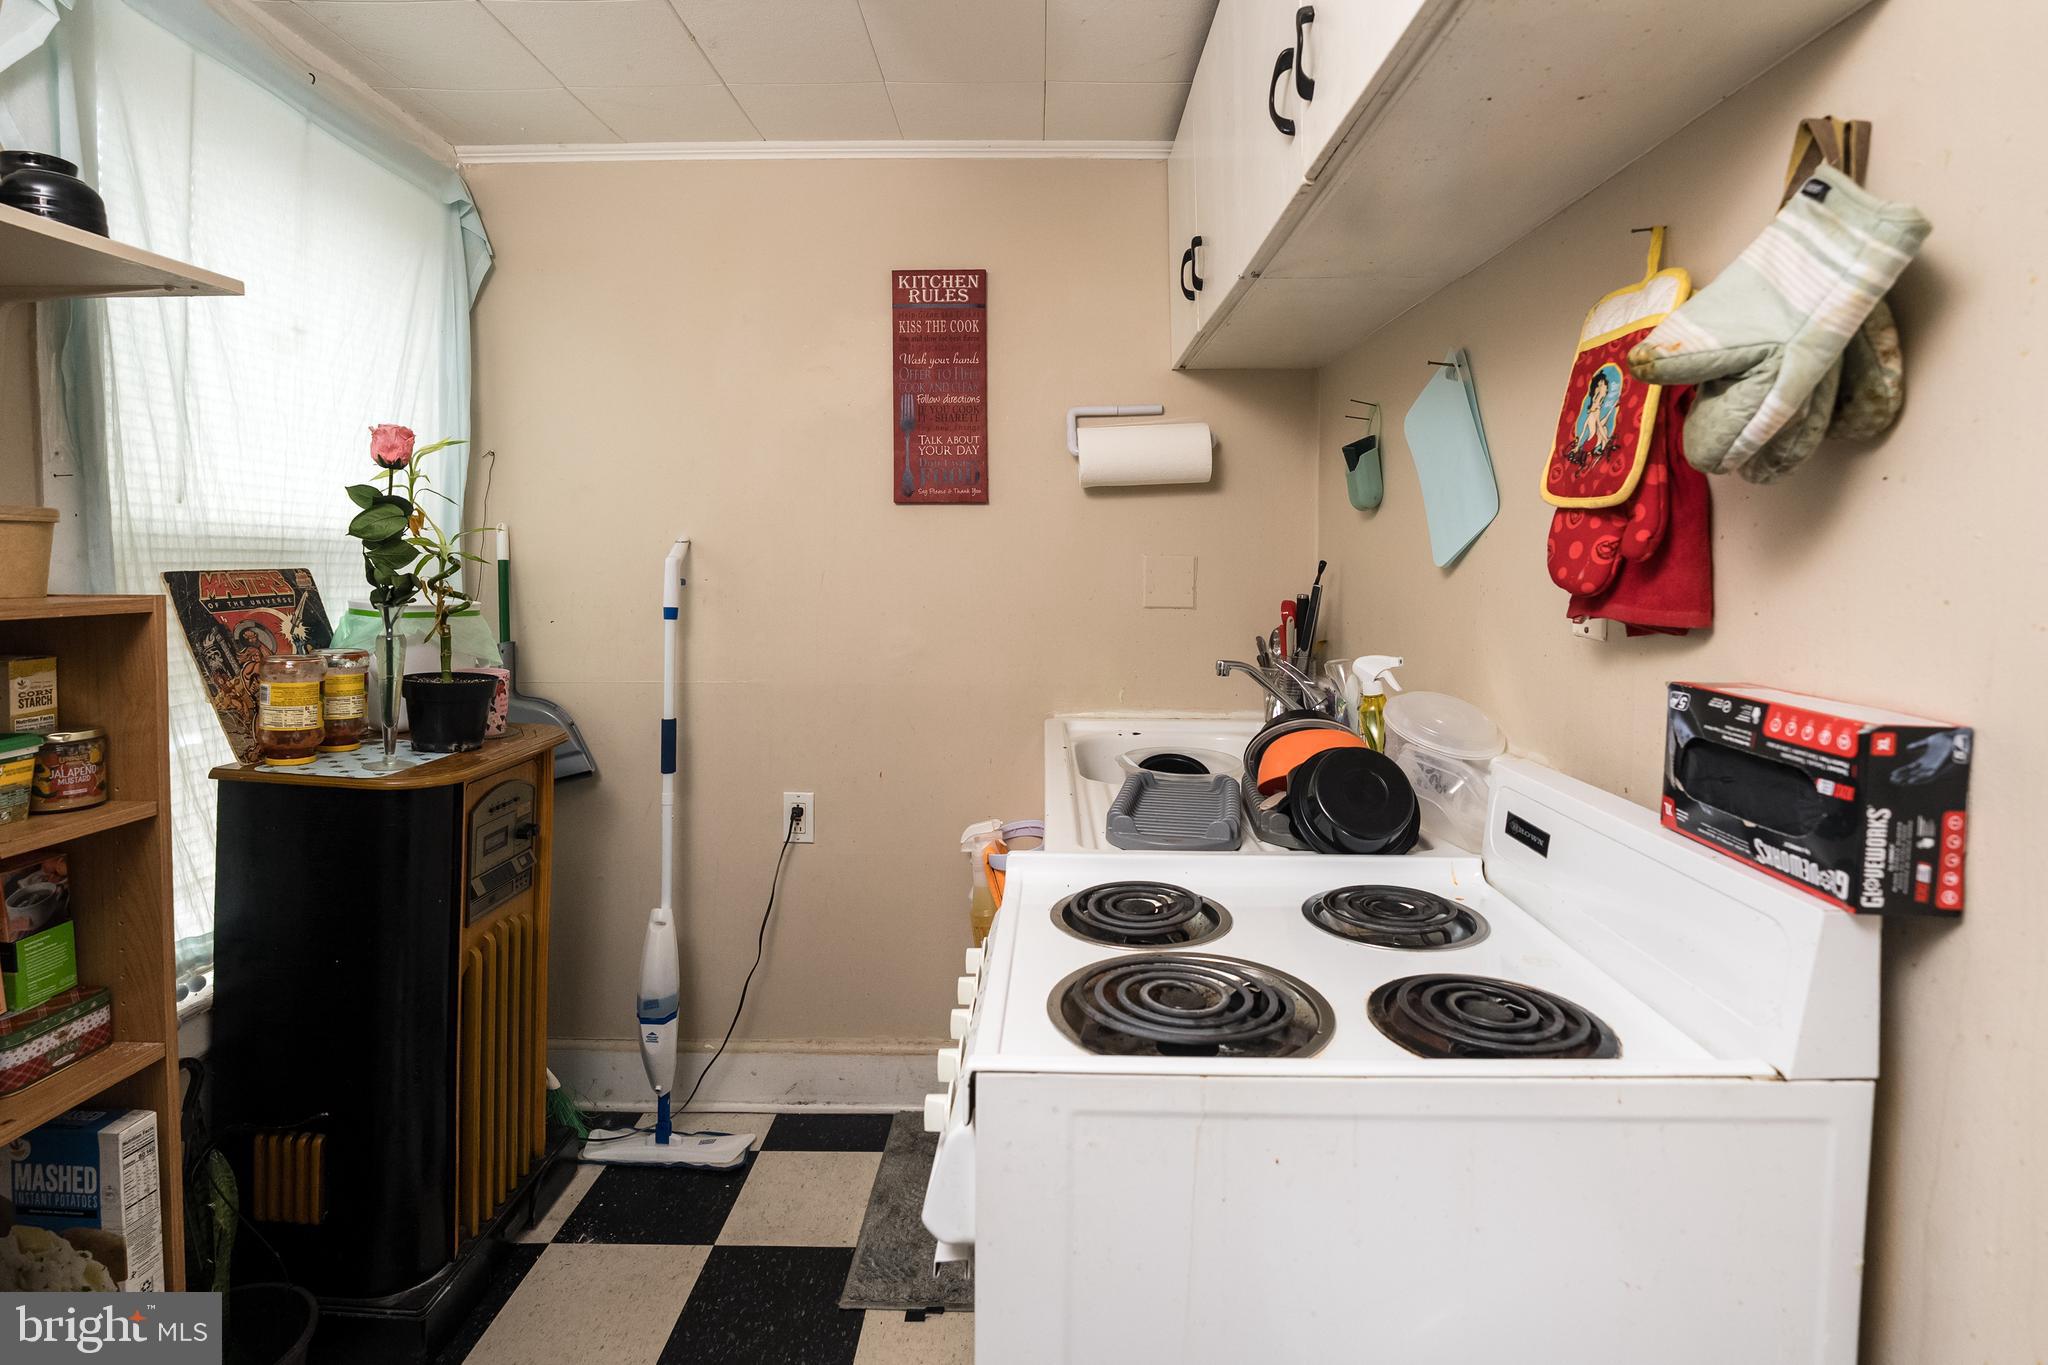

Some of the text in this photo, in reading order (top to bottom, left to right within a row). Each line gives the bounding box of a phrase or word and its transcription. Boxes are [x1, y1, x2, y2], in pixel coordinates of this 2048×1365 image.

[898, 274, 979, 289] KITCHEN
[908, 288, 968, 303] RULES
[899, 319, 980, 334] KISS THE COOK
[899, 352, 980, 368] Wash your hands
[917, 394, 980, 404] Follow directions
[952, 405, 980, 414] COOK
[918, 435, 980, 445] TALK ABOUT
[918, 445, 980, 456] YOUR DAY
[971, 488, 982, 496] You
[200, 572, 294, 600] MASTERS
[250, 598, 293, 606] UNIVERSE
[18, 689, 53, 698] CORN
[18, 695, 53, 709] STARCH
[57, 775, 91, 785] MUSTARD
[1860, 806, 1892, 909] GLOVEWORKS
[14, 1162, 97, 1194] MASHED
[14, 1192, 98, 1209] INSTANT POTATOES
